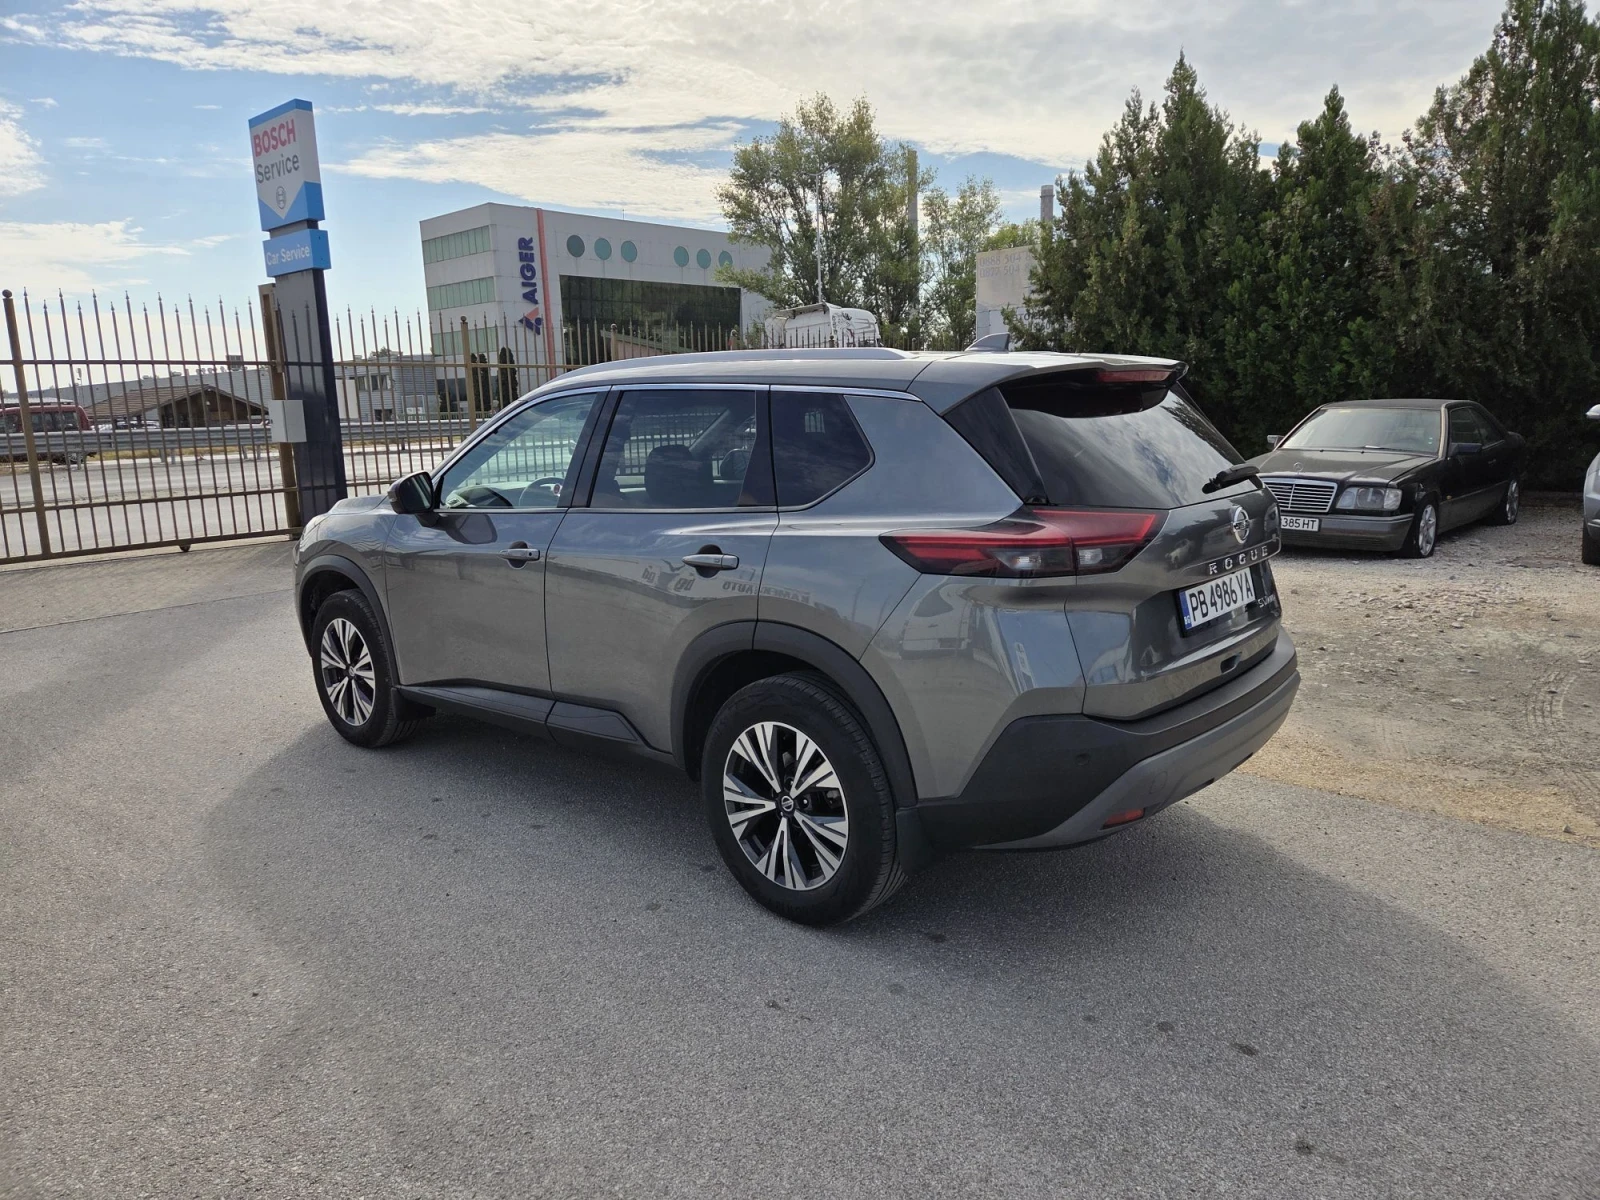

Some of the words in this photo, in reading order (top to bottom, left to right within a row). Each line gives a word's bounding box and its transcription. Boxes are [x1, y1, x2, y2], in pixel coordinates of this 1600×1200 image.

[253, 118, 296, 157] BOSCH
[256, 153, 300, 184] Service
[266, 252, 279, 265] Car
[281, 244, 310, 262] Service
[518, 237, 539, 305] AIGER
[1282, 517, 1300, 529] 385
[1302, 519, 1316, 530] HT
[1208, 545, 1268, 575] ROGUE
[1189, 589, 1209, 622] PB
[1209, 577, 1238, 613] 4986
[1236, 572, 1254, 602] YA
